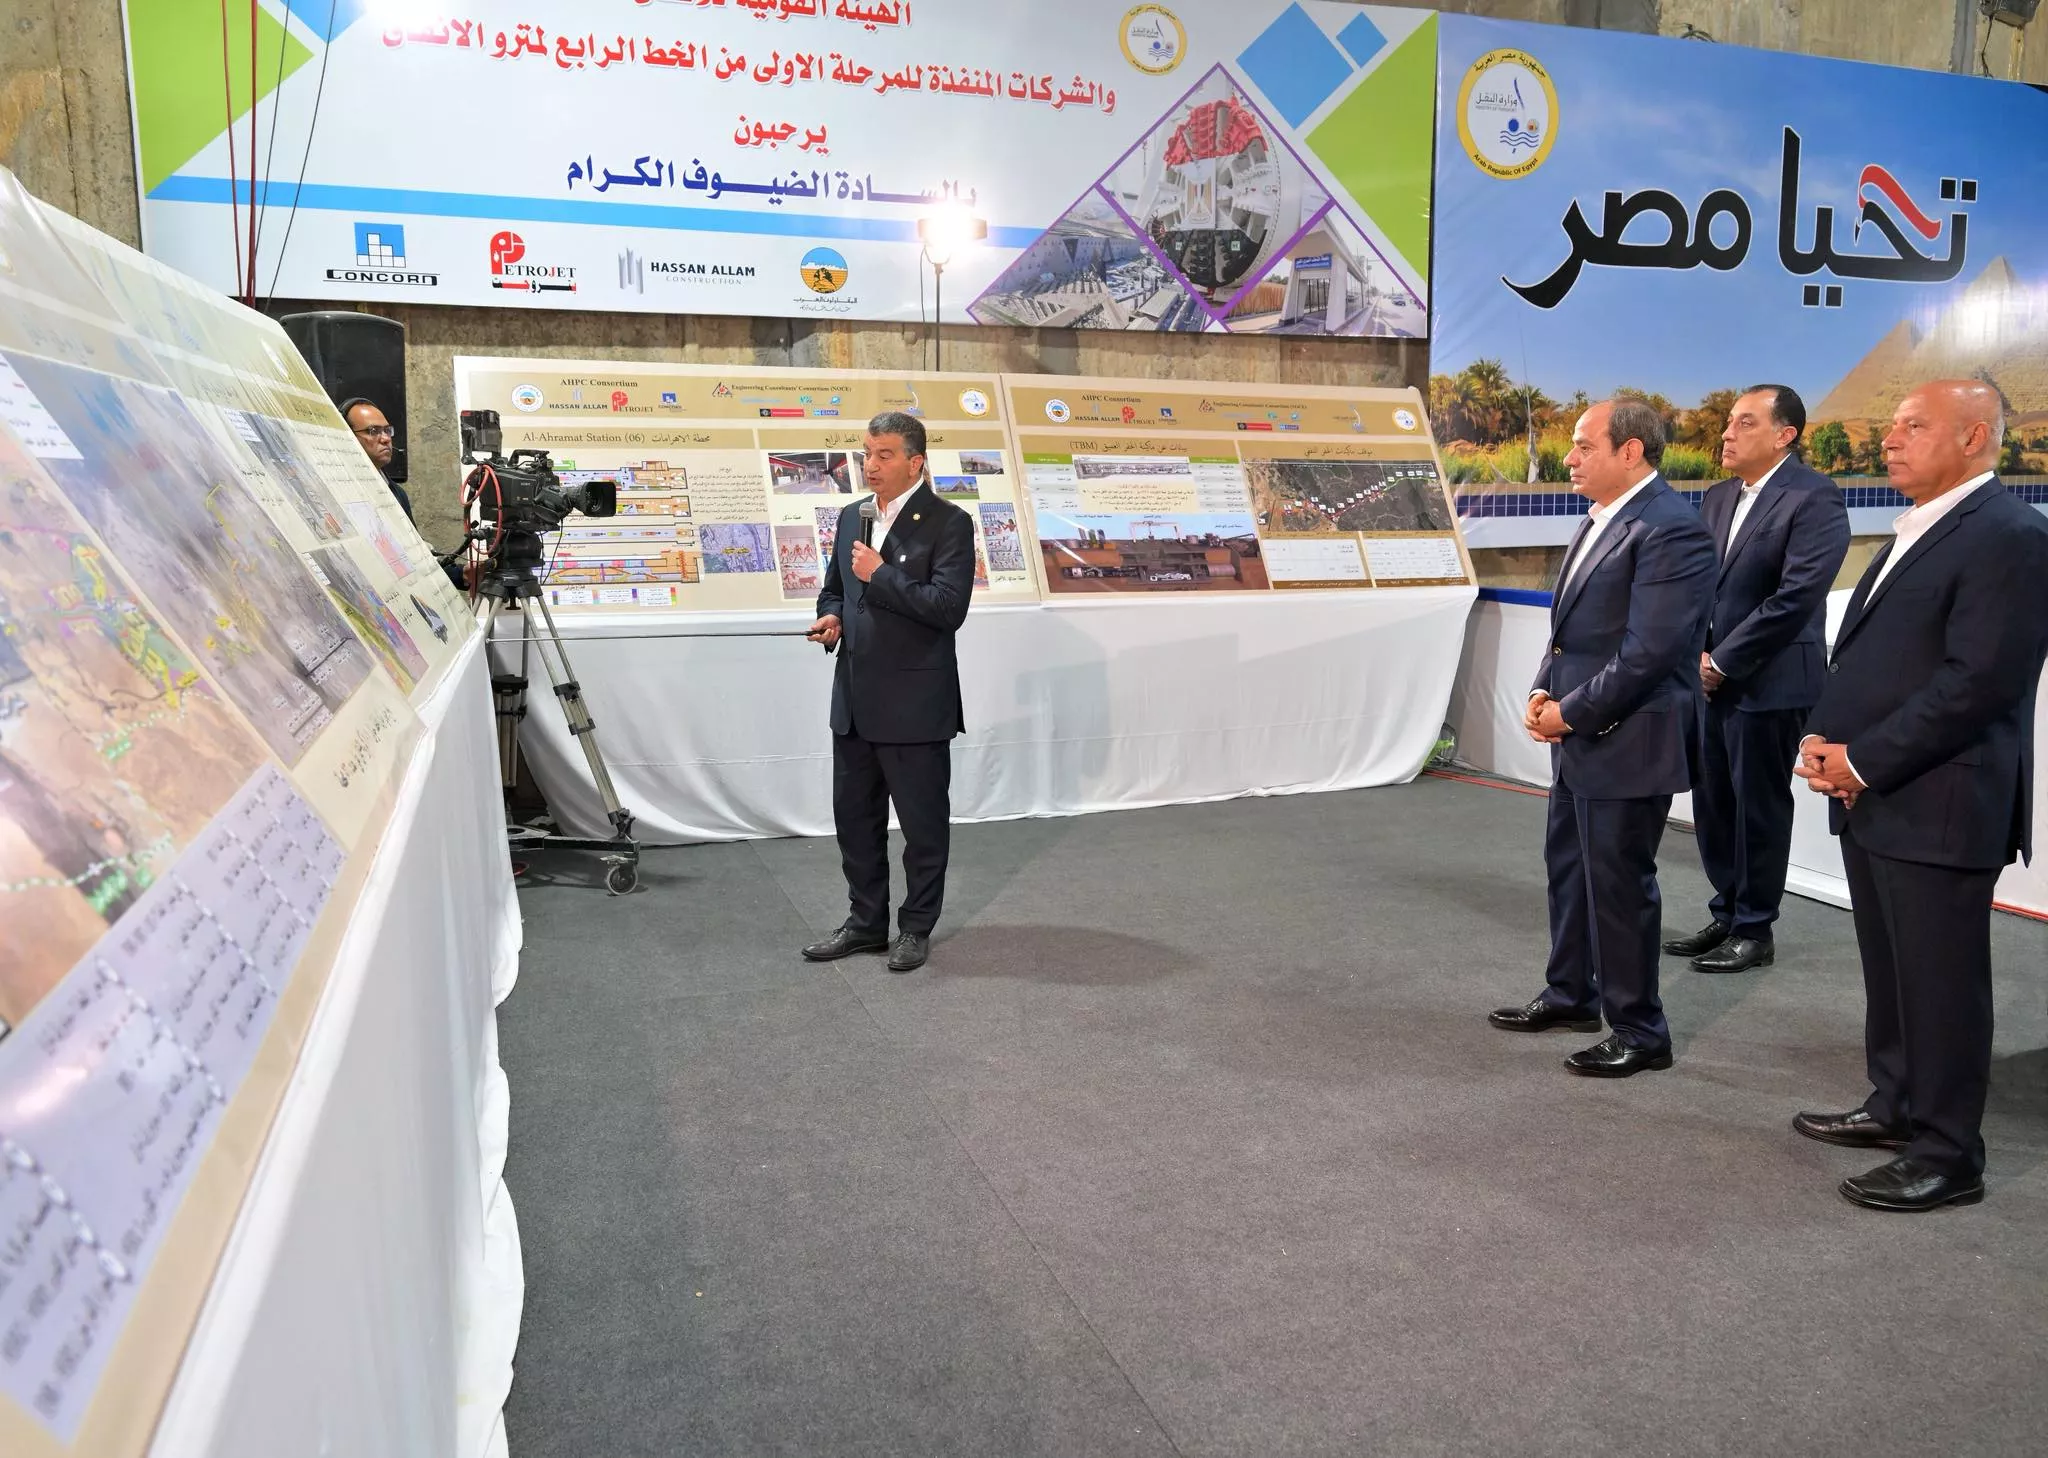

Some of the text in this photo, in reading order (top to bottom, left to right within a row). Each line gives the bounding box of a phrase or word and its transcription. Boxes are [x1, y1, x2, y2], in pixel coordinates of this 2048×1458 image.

[489, 23, 548, 58] لمترو
[555, 33, 635, 69] الرابع
[643, 37, 707, 68] الخط
[715, 47, 746, 79] من
[753, 53, 823, 84] الاولى
[1500, 53, 1516, 62] مصر
[831, 53, 923, 95] للمرحلة
[927, 66, 1001, 99] المنفذة
[1007, 73, 1117, 113] والشركات
[734, 115, 830, 154] يرحبون
[567, 154, 675, 192] الكرام
[1473, 154, 1487, 168] Arab
[1488, 165, 1513, 176] Republic
[1522, 157, 1538, 172] Egypt
[682, 158, 829, 204] الضيوف
[1501, 125, 1979, 310] تحيا مصر
[650, 261, 756, 277] HASSAN ALLAM
[665, 275, 742, 285] CONSTRUCTION
[560, 378, 639, 388] AHPC Consortium
[522, 431, 645, 444] Al-Ahramat Station (06)
[651, 432, 710, 445] محطة الاهرامات
[1069, 440, 1098, 452] (TBM)
